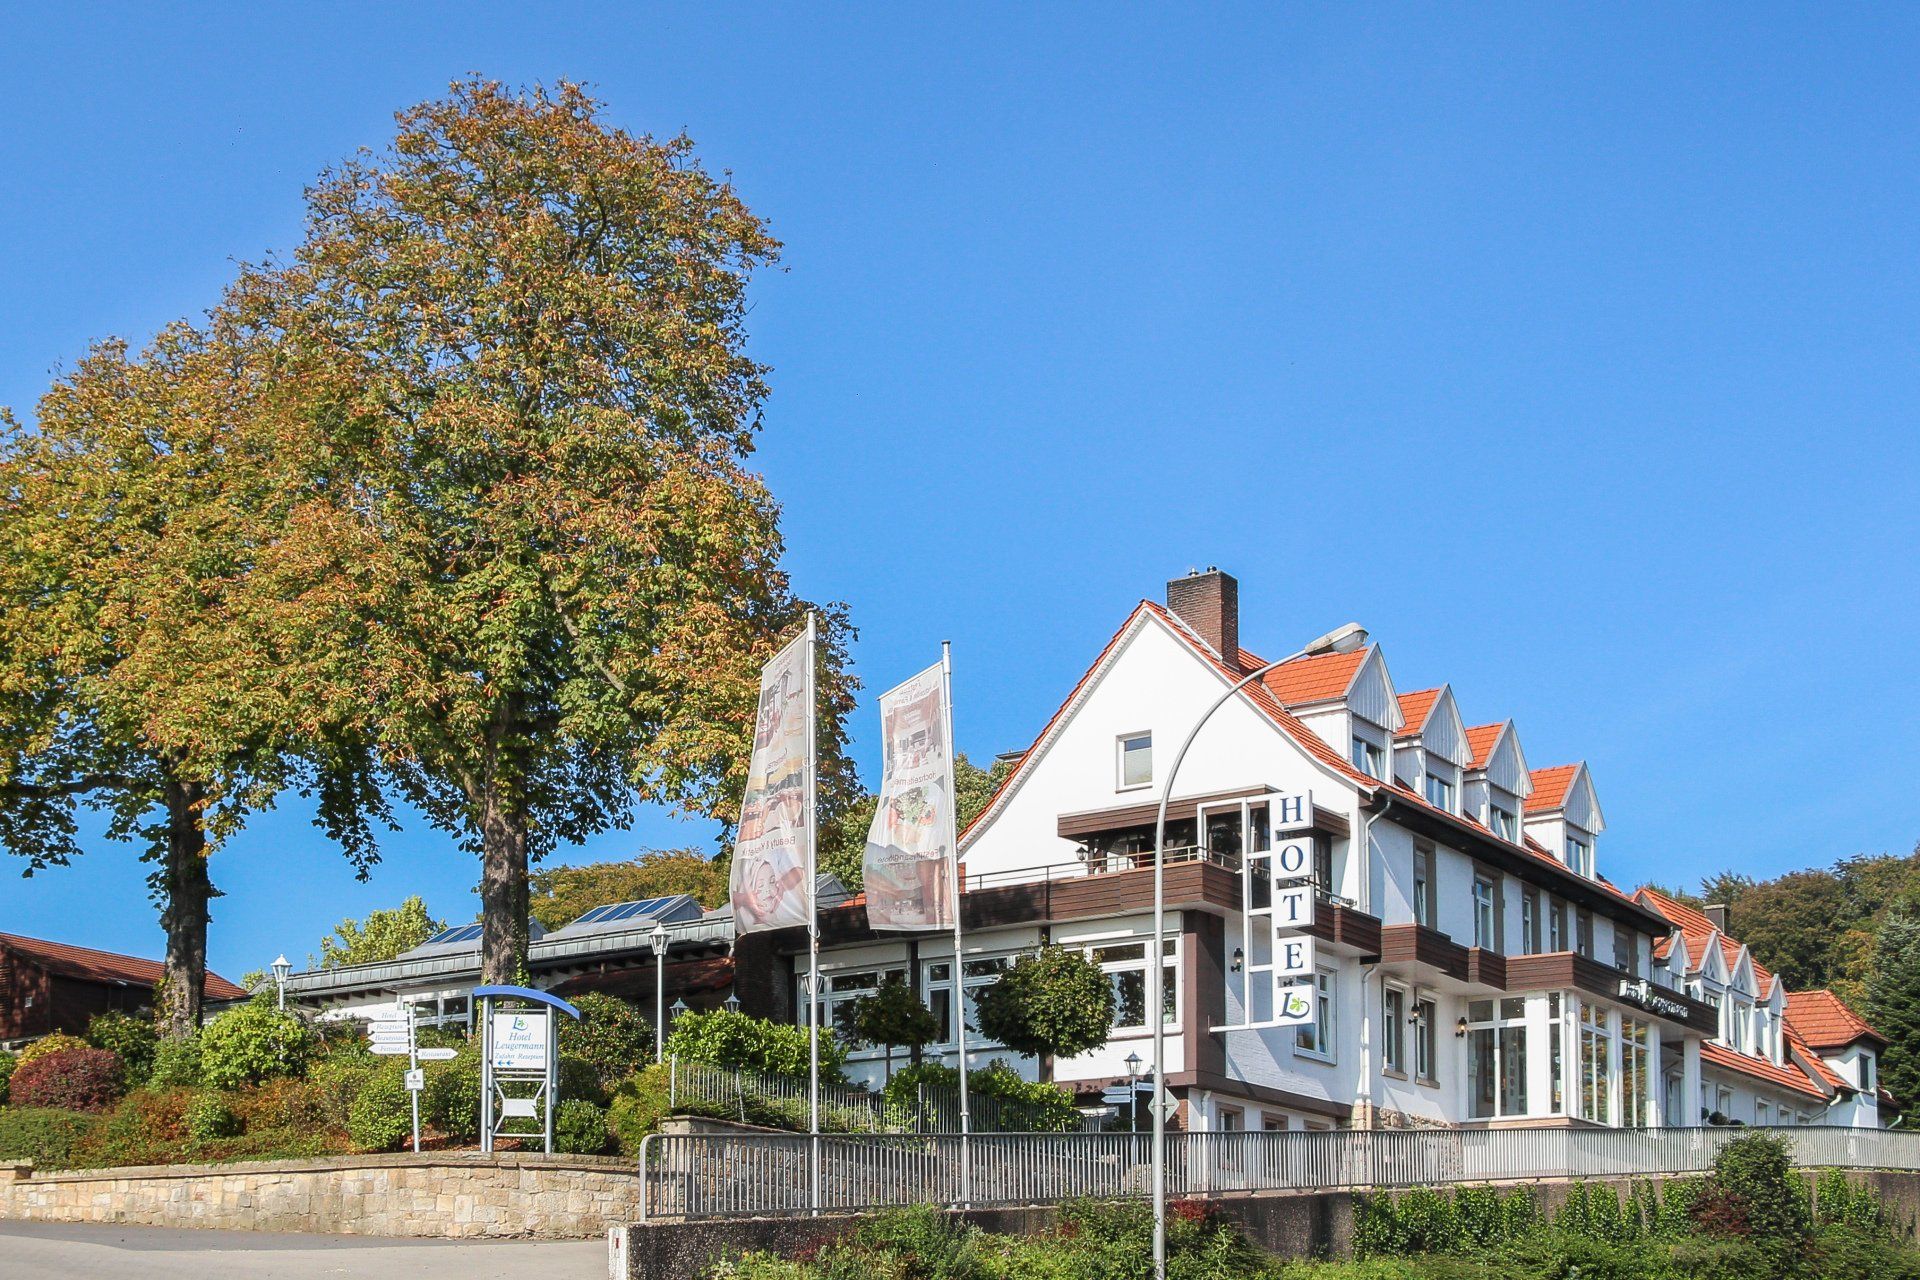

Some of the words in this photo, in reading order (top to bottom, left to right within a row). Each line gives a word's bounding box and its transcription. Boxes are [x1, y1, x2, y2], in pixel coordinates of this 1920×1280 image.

[509, 1032, 532, 1041] Hotel
[495, 1041, 545, 1051] Leugermann
[495, 1052, 515, 1060] Zufahrt
